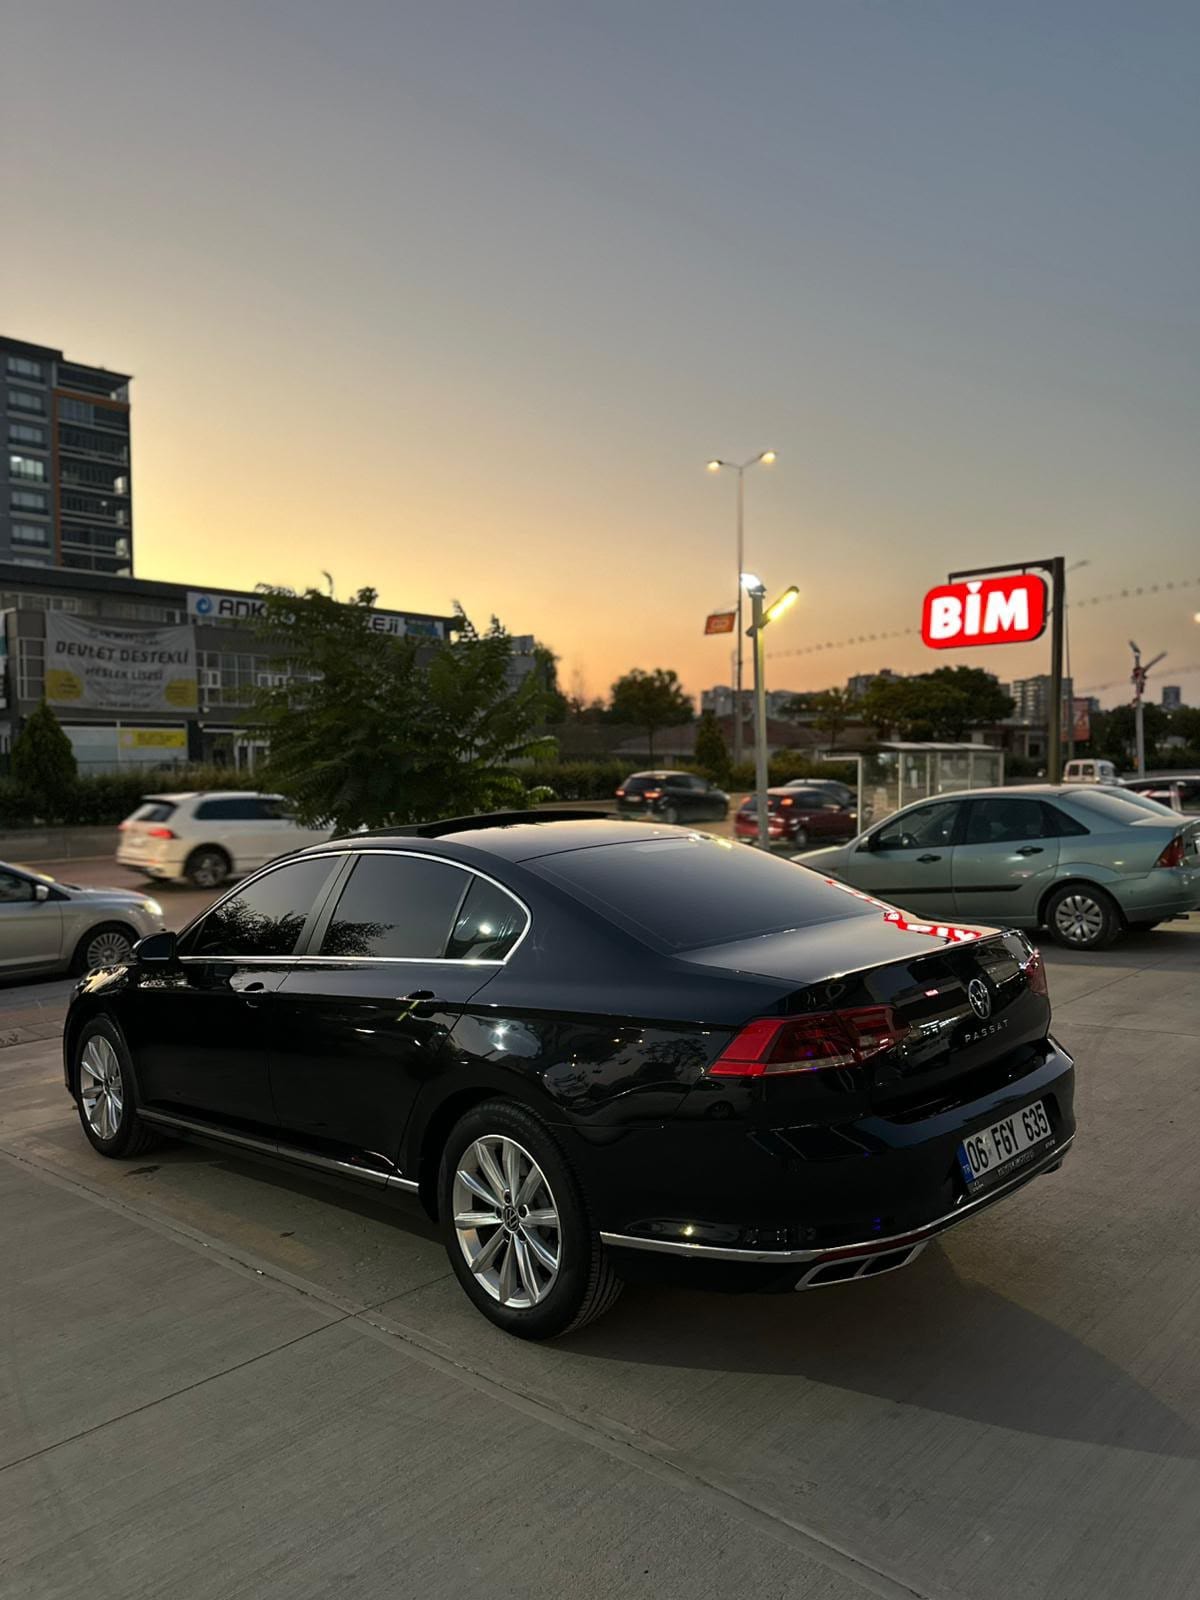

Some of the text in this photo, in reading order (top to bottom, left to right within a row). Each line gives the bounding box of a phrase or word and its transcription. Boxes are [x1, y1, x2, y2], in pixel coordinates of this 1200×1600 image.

[218, 599, 266, 618] ANK
[929, 581, 1029, 640] BİM
[55, 641, 115, 661] DEVLET
[120, 649, 189, 664] DESTEKLİ
[964, 1019, 1009, 1043] PASSAT
[966, 1136, 989, 1173] 06
[991, 1118, 1019, 1160] FGY
[1022, 1103, 1048, 1142] 635
